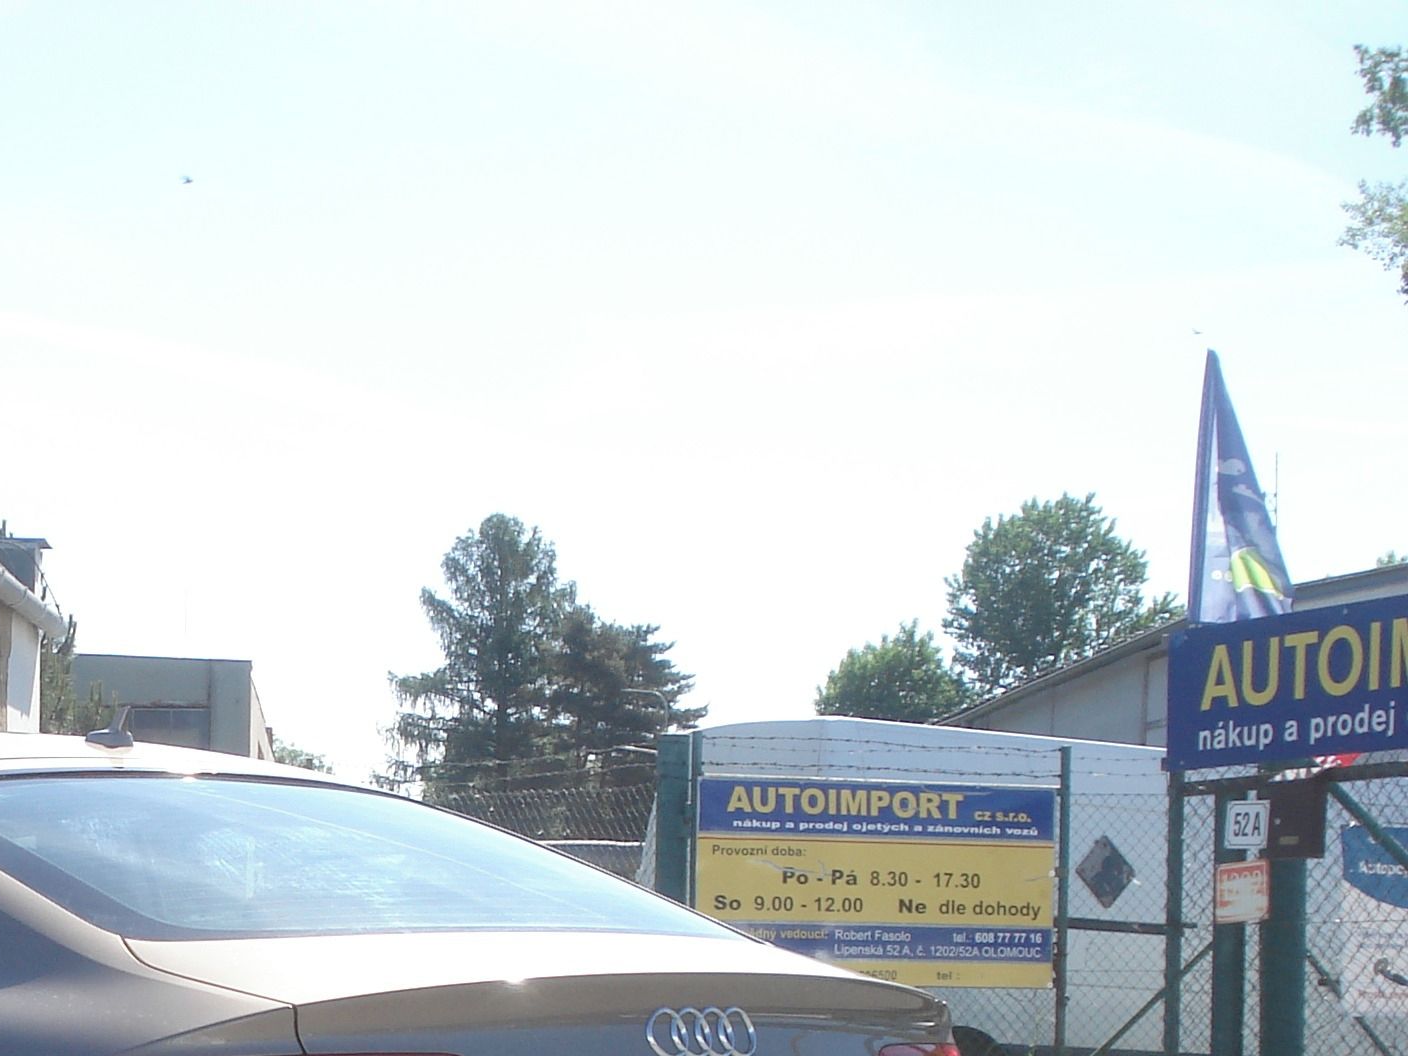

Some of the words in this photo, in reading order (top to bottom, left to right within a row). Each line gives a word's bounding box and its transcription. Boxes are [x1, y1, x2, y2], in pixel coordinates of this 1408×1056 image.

[1198, 720, 1273, 751] nákup
[1284, 720, 1298, 742] a
[1309, 701, 1396, 745] prodej
[726, 785, 964, 820] AUTOIMPORT
[974, 811, 992, 821] cz
[995, 812, 1032, 823] s.r.o.
[732, 819, 781, 830] nákup
[785, 821, 794, 829] a
[799, 821, 848, 832] prodej
[852, 822, 909, 832] ojetých
[914, 824, 923, 832] a
[927, 824, 1000, 835] zánovních
[712, 845, 768, 856] Provozní
[771, 846, 807, 857] doba:
[782, 867, 809, 885] Po
[831, 869, 858, 886] Pá
[869, 871, 908, 887] 8.30
[933, 872, 981, 889] 17.30
[714, 895, 742, 911] So
[754, 896, 794, 912] 9.00
[814, 897, 864, 913] 12.00
[898, 899, 927, 914] Ne
[939, 900, 967, 915] dle
[972, 901, 1041, 921] dohody
[834, 929, 872, 941] Robert
[975, 932, 995, 944] 608
[997, 933, 1011, 944] 77
[1013, 933, 1027, 944] 77
[1030, 933, 1043, 944] 16
[834, 944, 883, 957] Lipenská
[982, 946, 1042, 958] OLOMOUC
